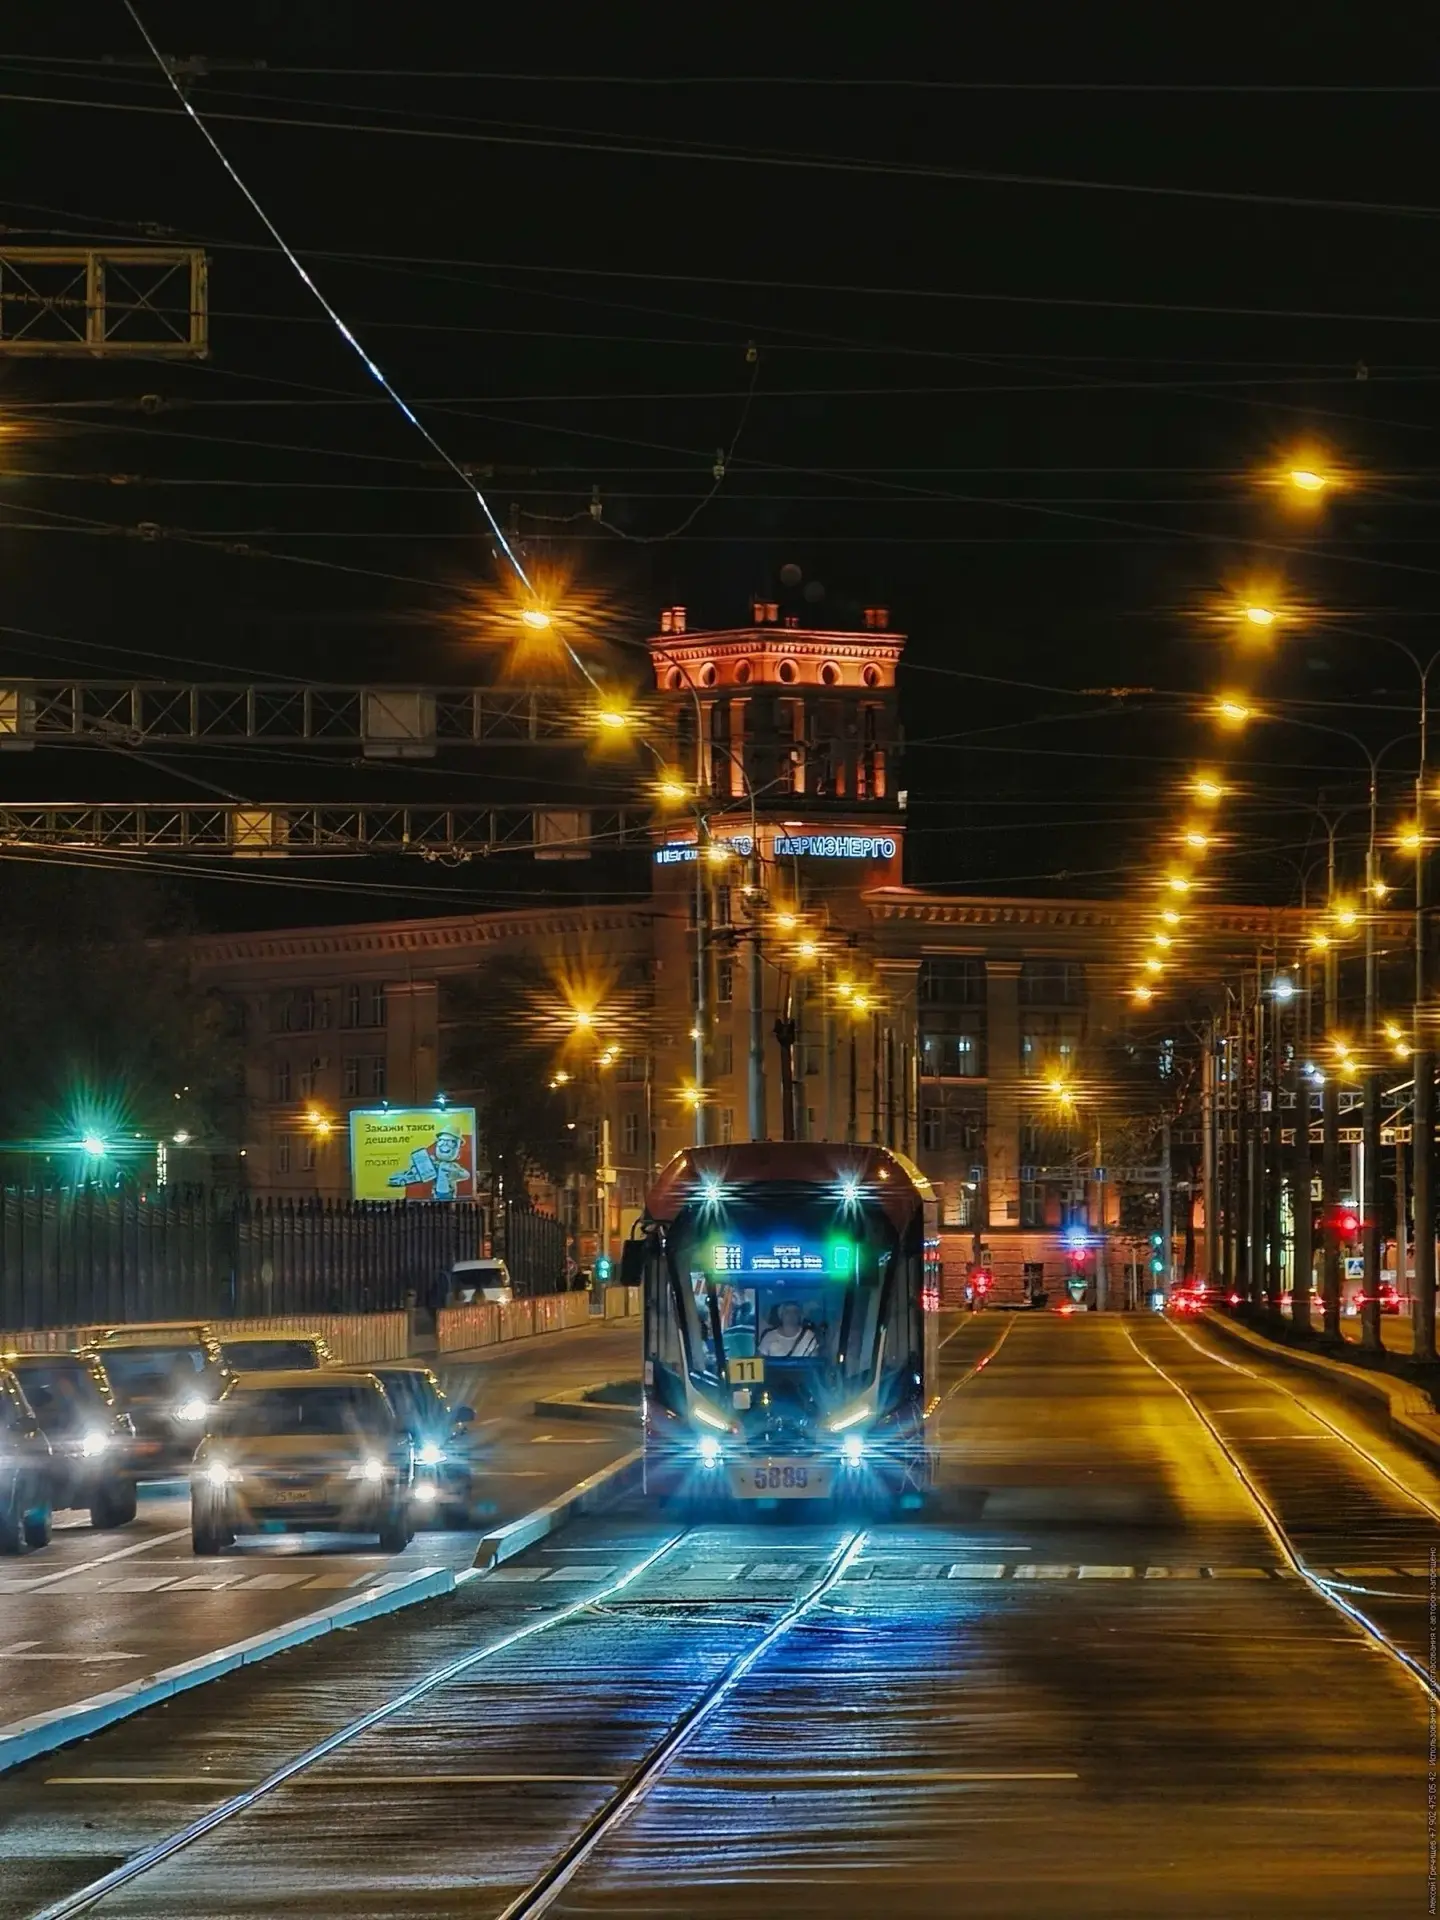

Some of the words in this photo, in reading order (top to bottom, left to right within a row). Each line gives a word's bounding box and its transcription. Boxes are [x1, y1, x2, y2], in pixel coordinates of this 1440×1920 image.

[773, 835, 896, 858] ПЕРМЭНЕРГО
[364, 1123, 404, 1133] Закажи
[406, 1124, 435, 1132] такси
[364, 1157, 400, 1167] maxim
[736, 1361, 756, 1381] 11
[754, 1466, 808, 1489] 5889
